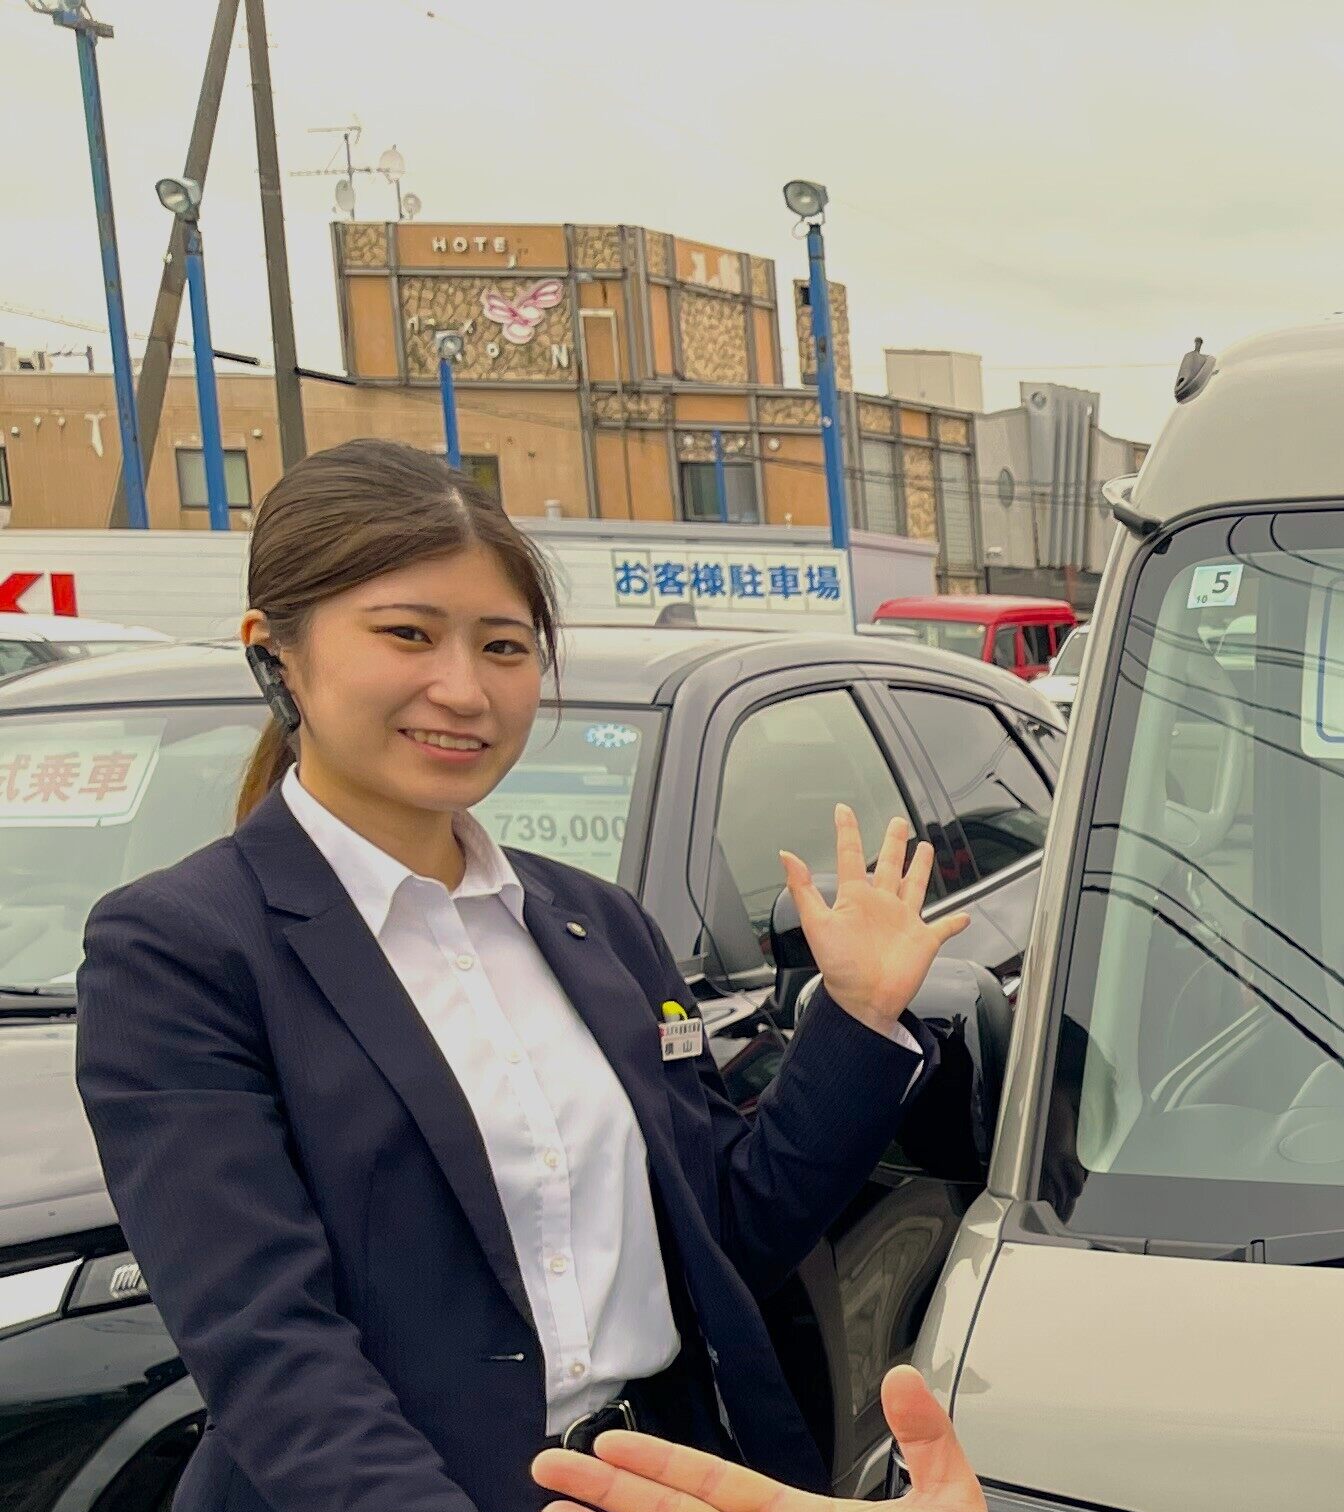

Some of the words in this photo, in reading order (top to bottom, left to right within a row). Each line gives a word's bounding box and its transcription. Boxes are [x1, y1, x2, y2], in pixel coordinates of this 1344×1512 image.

[614, 560, 841, 600] お客様駐車場
[1211, 570, 1233, 594] 5
